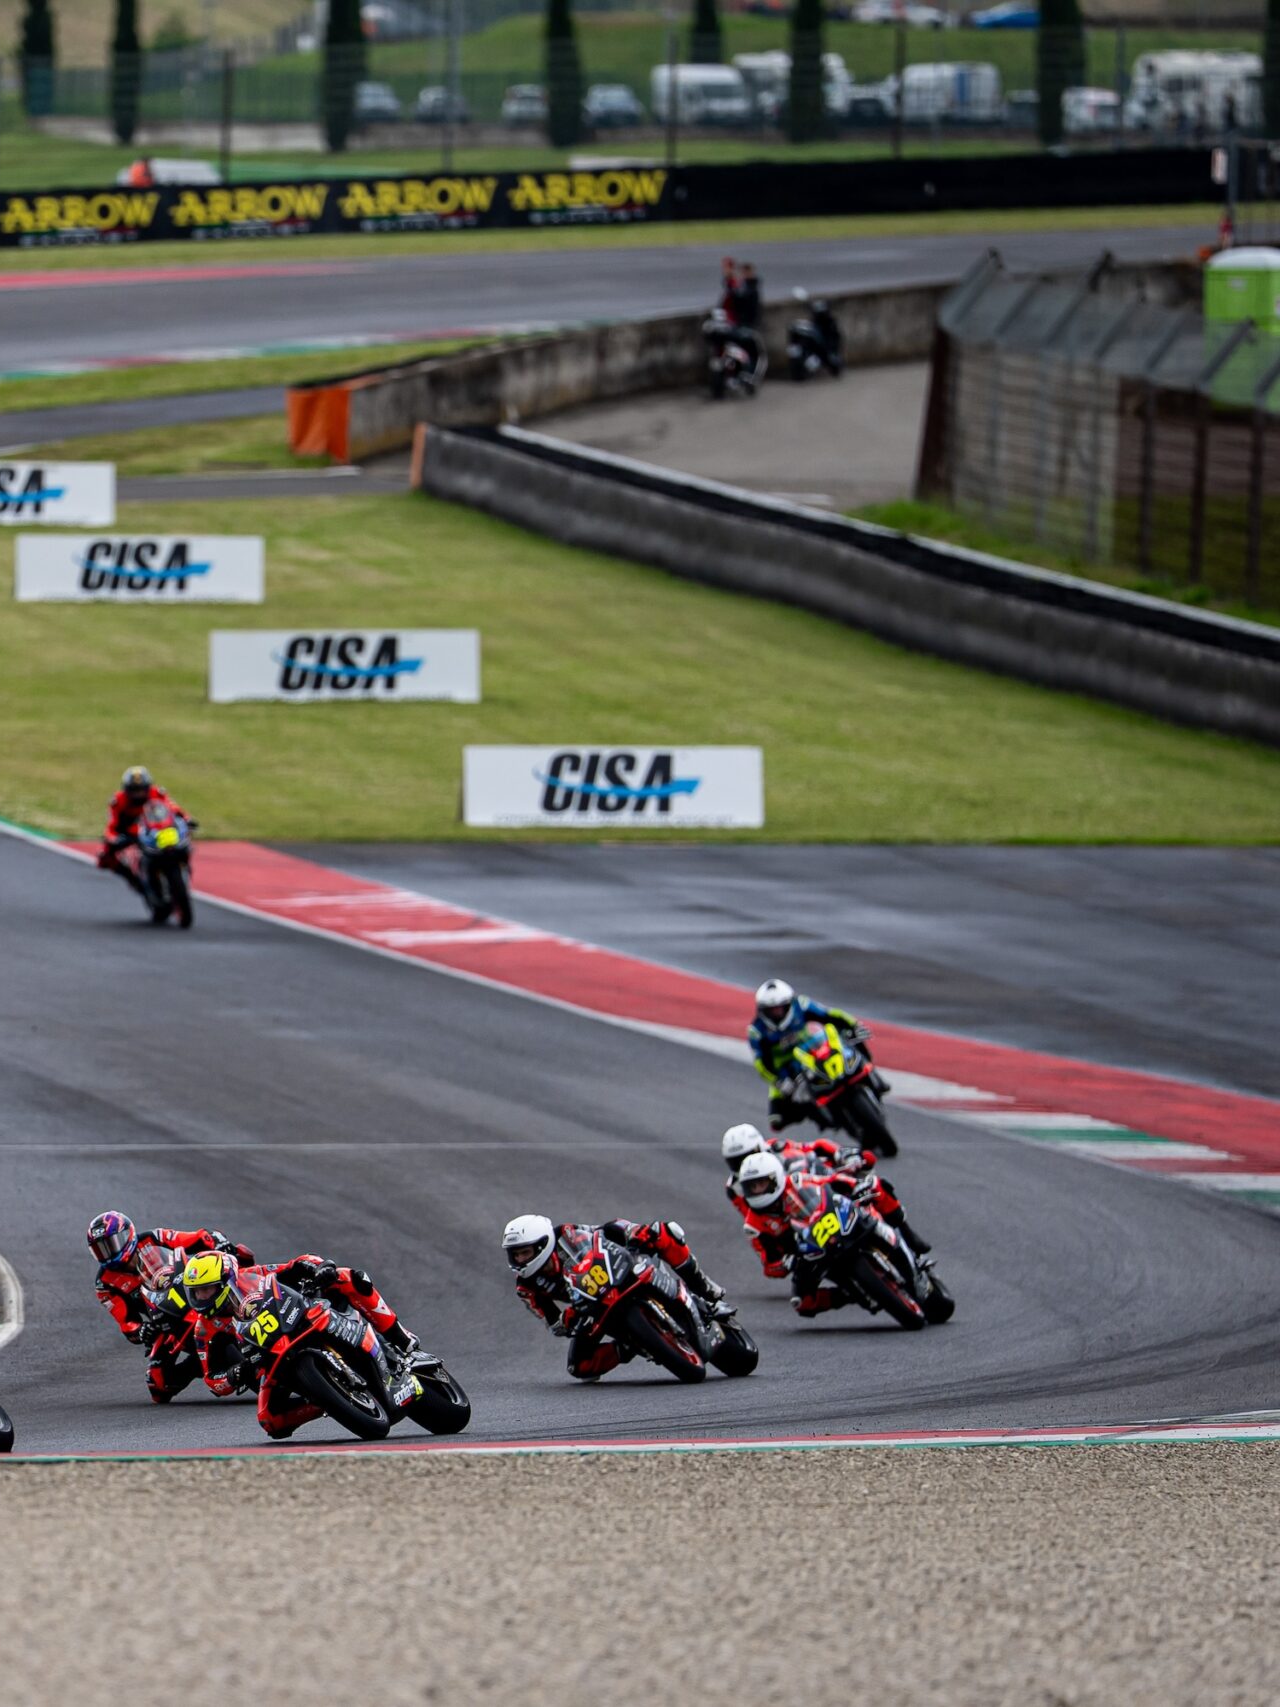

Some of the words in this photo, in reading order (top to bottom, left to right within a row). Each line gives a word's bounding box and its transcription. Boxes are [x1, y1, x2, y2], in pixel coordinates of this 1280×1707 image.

[170, 185, 328, 226] ARROW
[339, 178, 496, 218] ARROW
[509, 171, 666, 210] ARROW
[80, 542, 188, 592] CISA
[279, 636, 399, 692] CISA
[542, 753, 673, 813] CISA
[812, 1212, 841, 1248] 29
[581, 1264, 609, 1296] 38
[249, 1309, 280, 1347] 25
